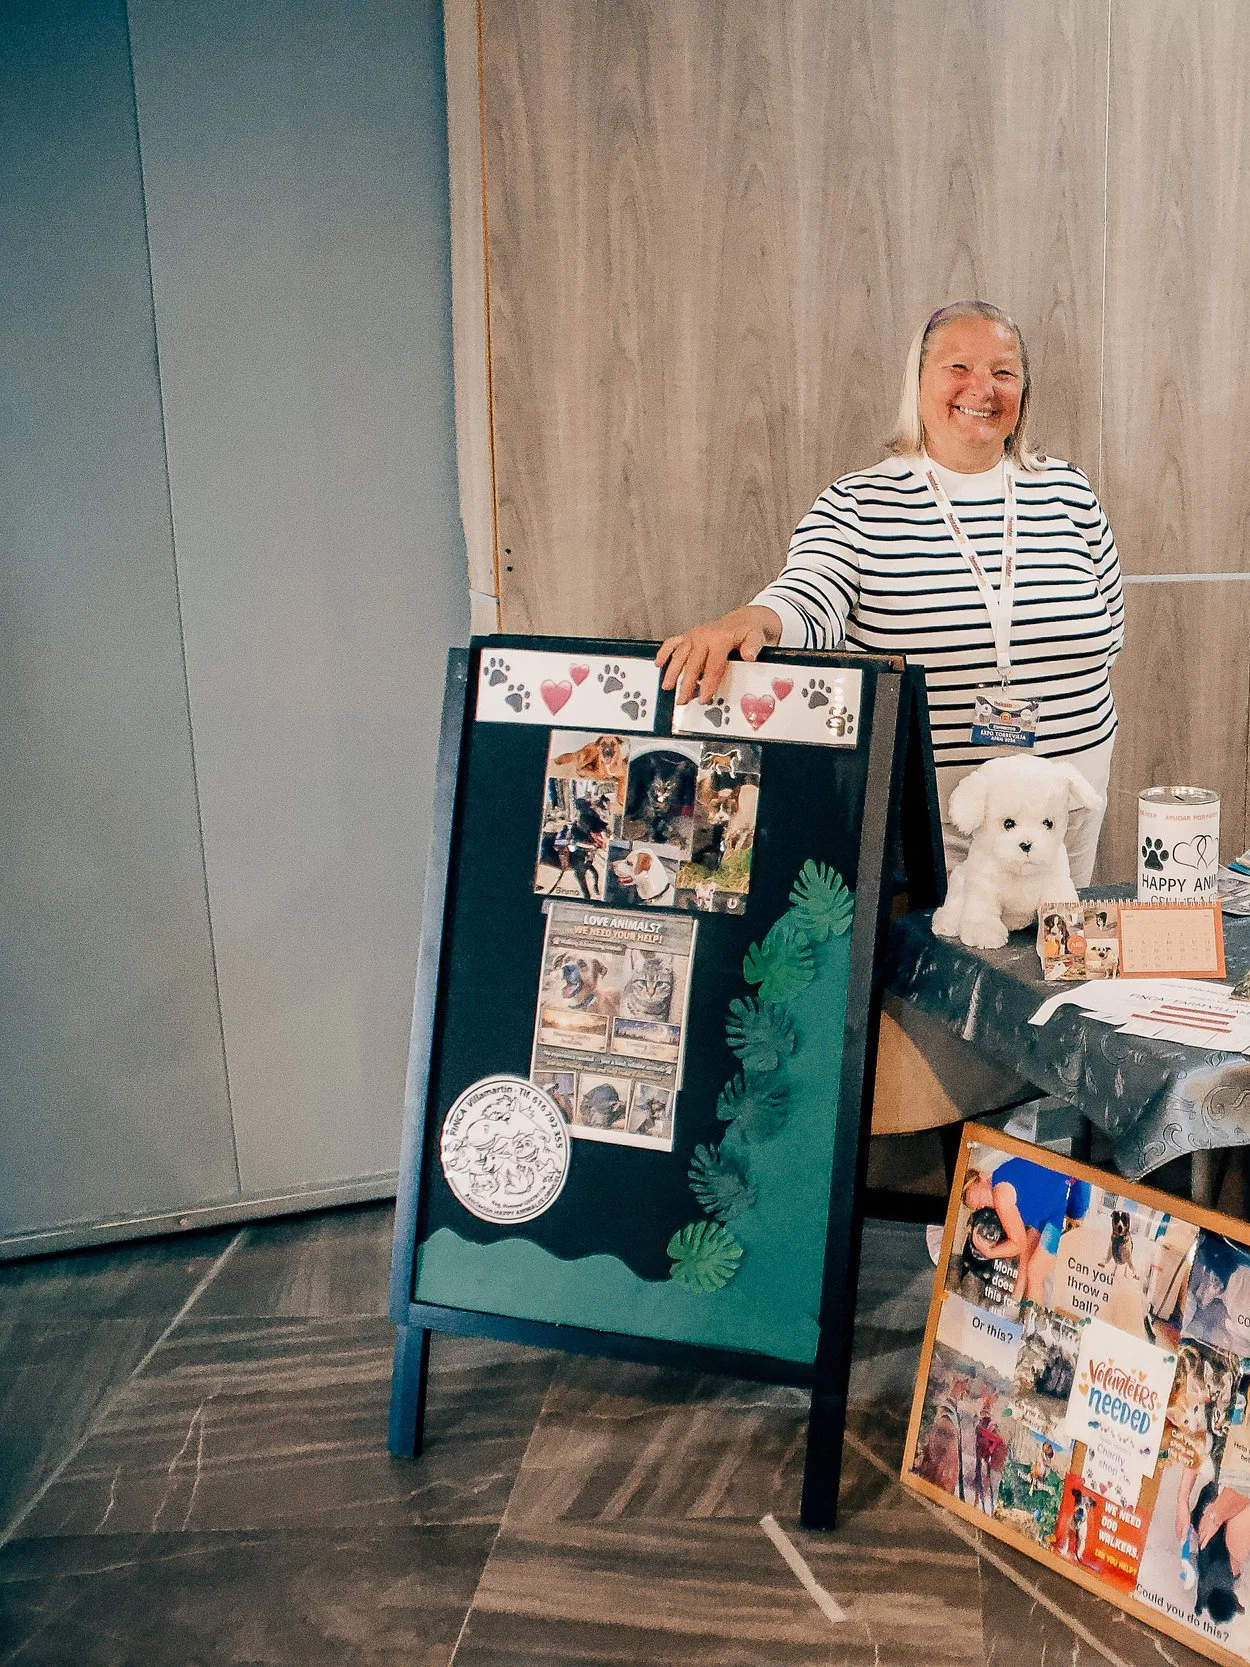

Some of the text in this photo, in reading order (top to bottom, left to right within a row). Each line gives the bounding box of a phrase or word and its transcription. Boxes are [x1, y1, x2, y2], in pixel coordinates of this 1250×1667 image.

[1142, 873, 1187, 892] HAPPY
[583, 914, 661, 933] LOVE ANIMALS?
[574, 925, 663, 944] WE NEED YOUR HELP!
[1129, 993, 1165, 1002] FINCA
[450, 1108, 468, 1137] FINCA
[466, 1084, 513, 1108] Villamartin
[993, 1259, 1019, 1279] Mona
[1067, 1257, 1114, 1287] Can you
[991, 1276, 1014, 1293] does
[1067, 1275, 1109, 1303] throw a
[984, 1286, 1002, 1303] this
[1072, 1295, 1100, 1315] ball?
[972, 1316, 1014, 1344] Or this?
[1097, 1443, 1126, 1467] Charity
[1234, 1442, 1248, 1453] Help
[1098, 1460, 1118, 1476] shop
[1101, 1515, 1118, 1532] DOG
[1105, 1501, 1142, 1529] WE NEED
[1136, 1583, 1230, 1643] Could you do this?
